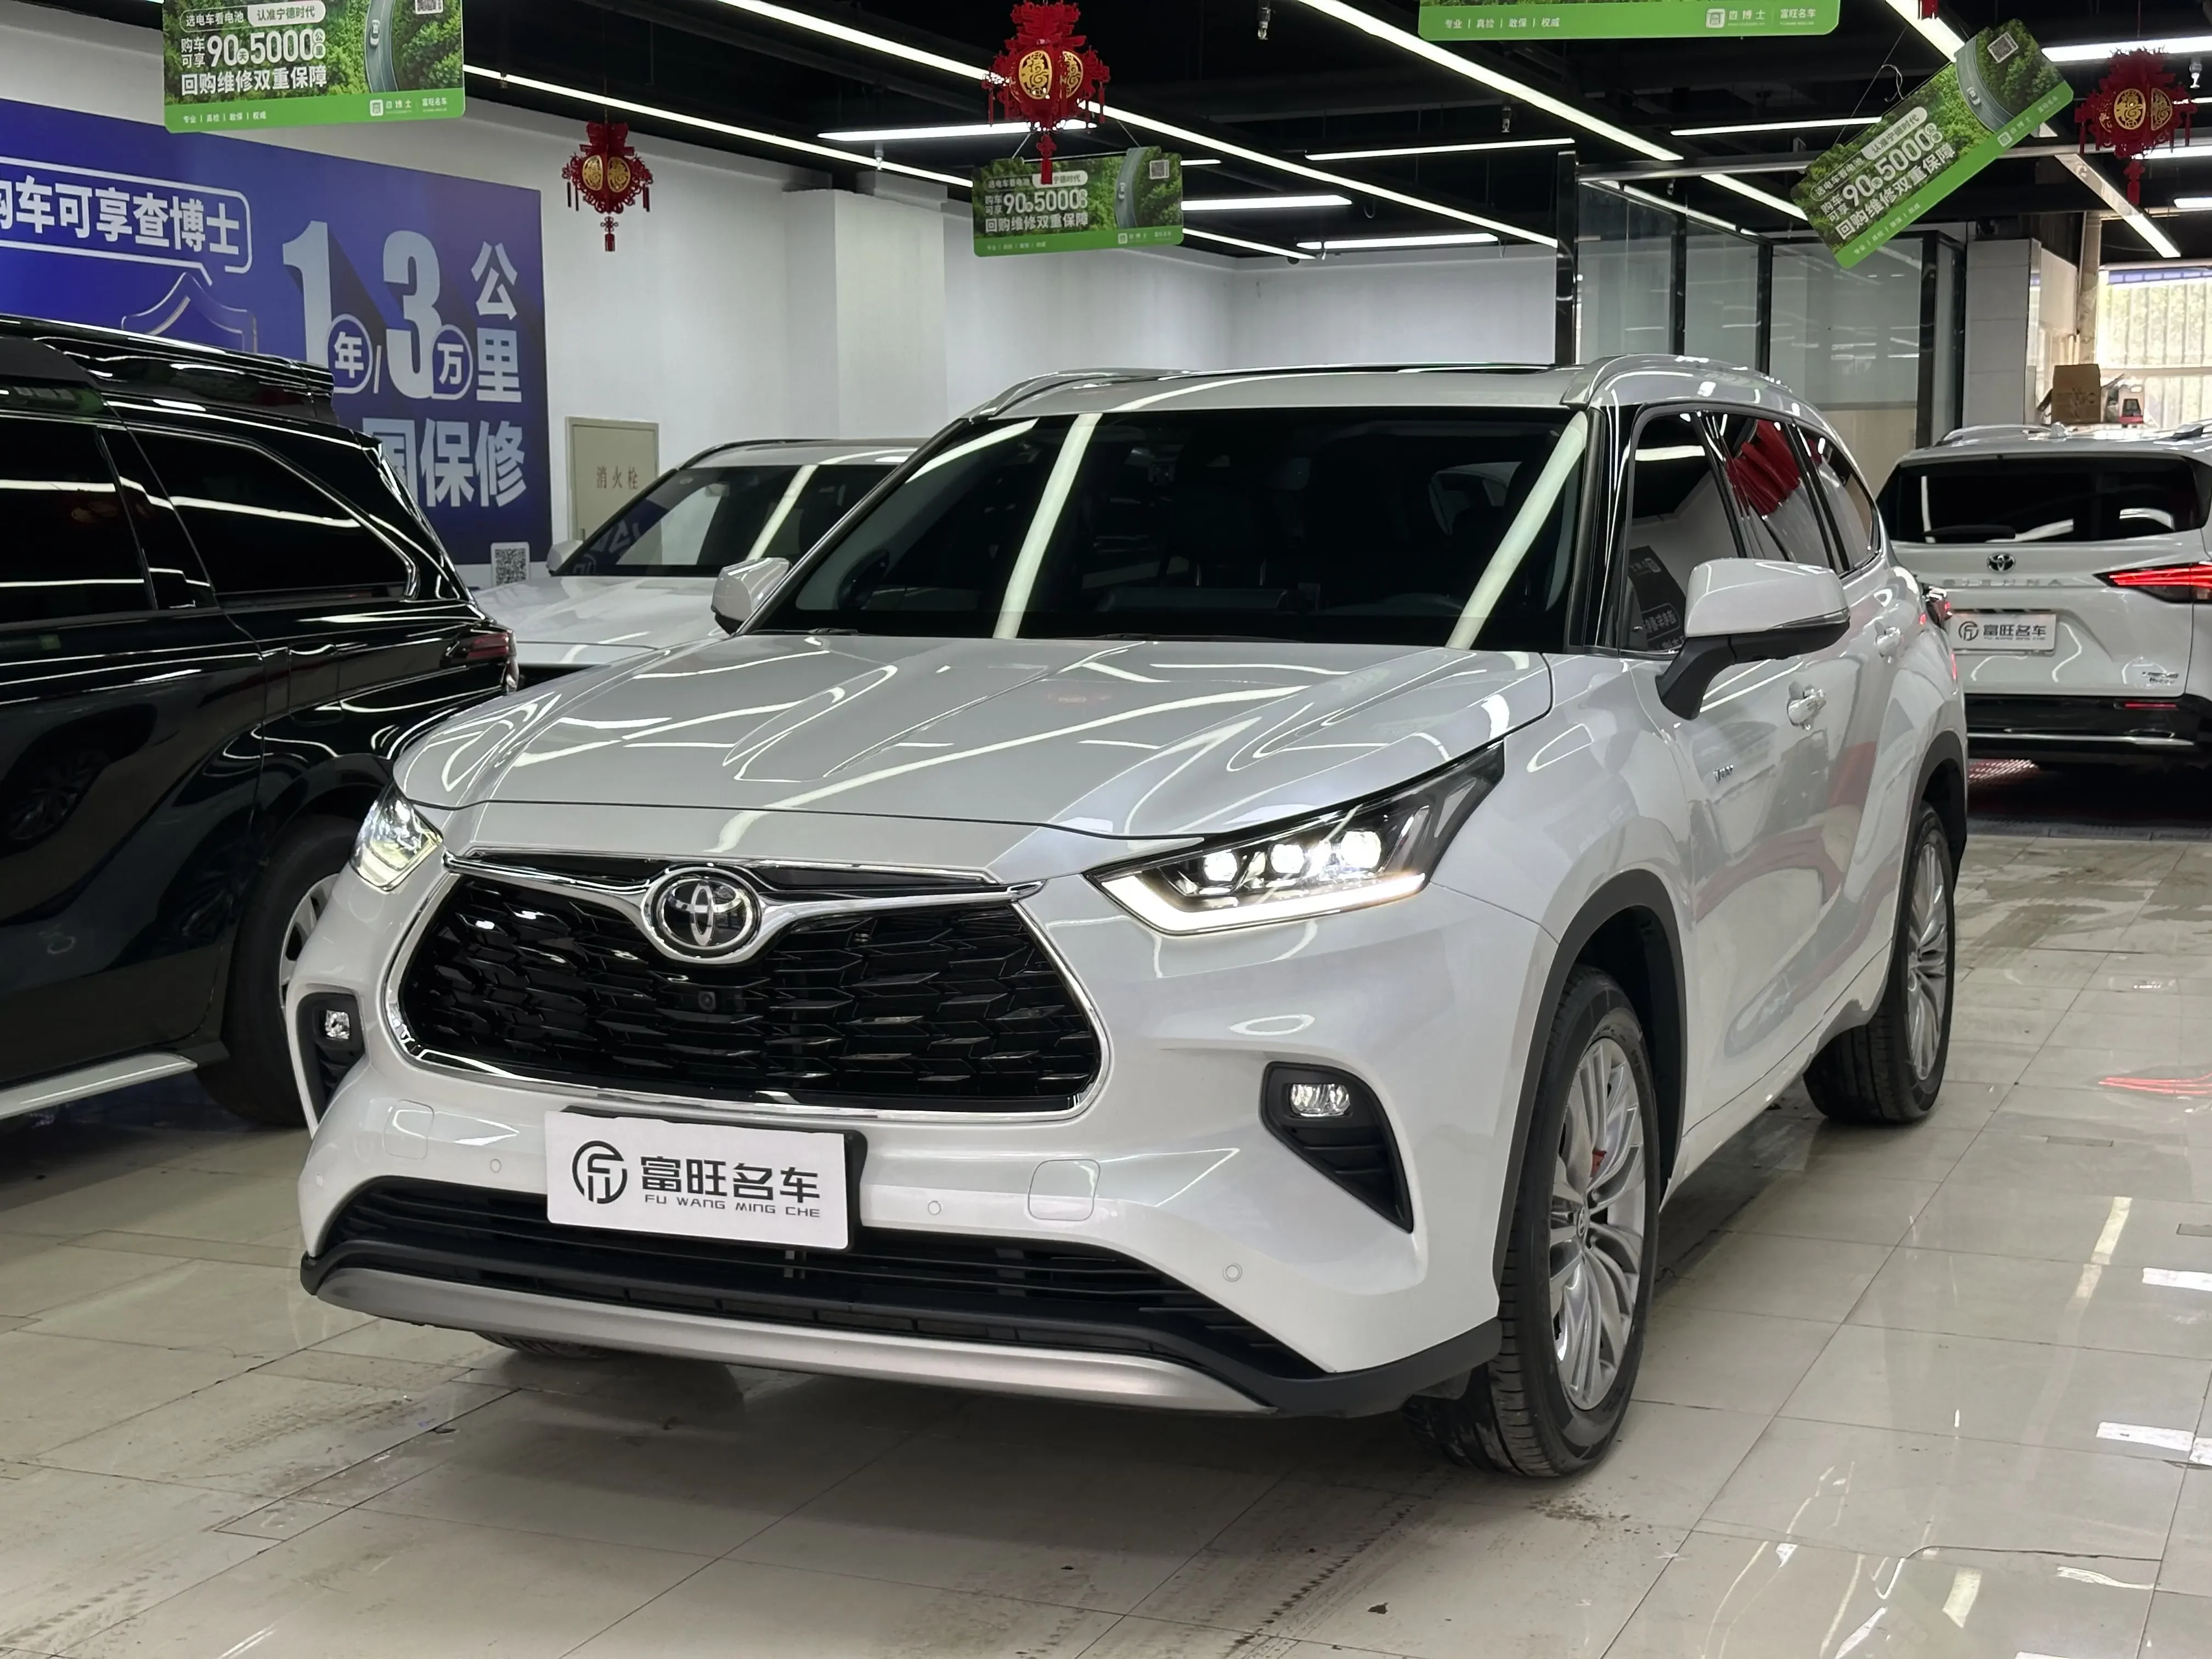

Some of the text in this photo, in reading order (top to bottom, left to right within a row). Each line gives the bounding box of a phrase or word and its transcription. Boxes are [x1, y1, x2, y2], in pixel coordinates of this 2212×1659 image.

[257, 6, 315, 21] 认准宁德时代
[181, 37, 205, 52] 购车
[181, 53, 205, 69] 可享
[181, 65, 327, 96] 回购维修双重保障
[1835, 143, 1955, 240] 回购维修双重保障
[1983, 624, 2046, 636] 富旺名车
[640, 1155, 820, 1203] 富旺名车
[645, 1194, 820, 1218] FU WANG MING CHE
